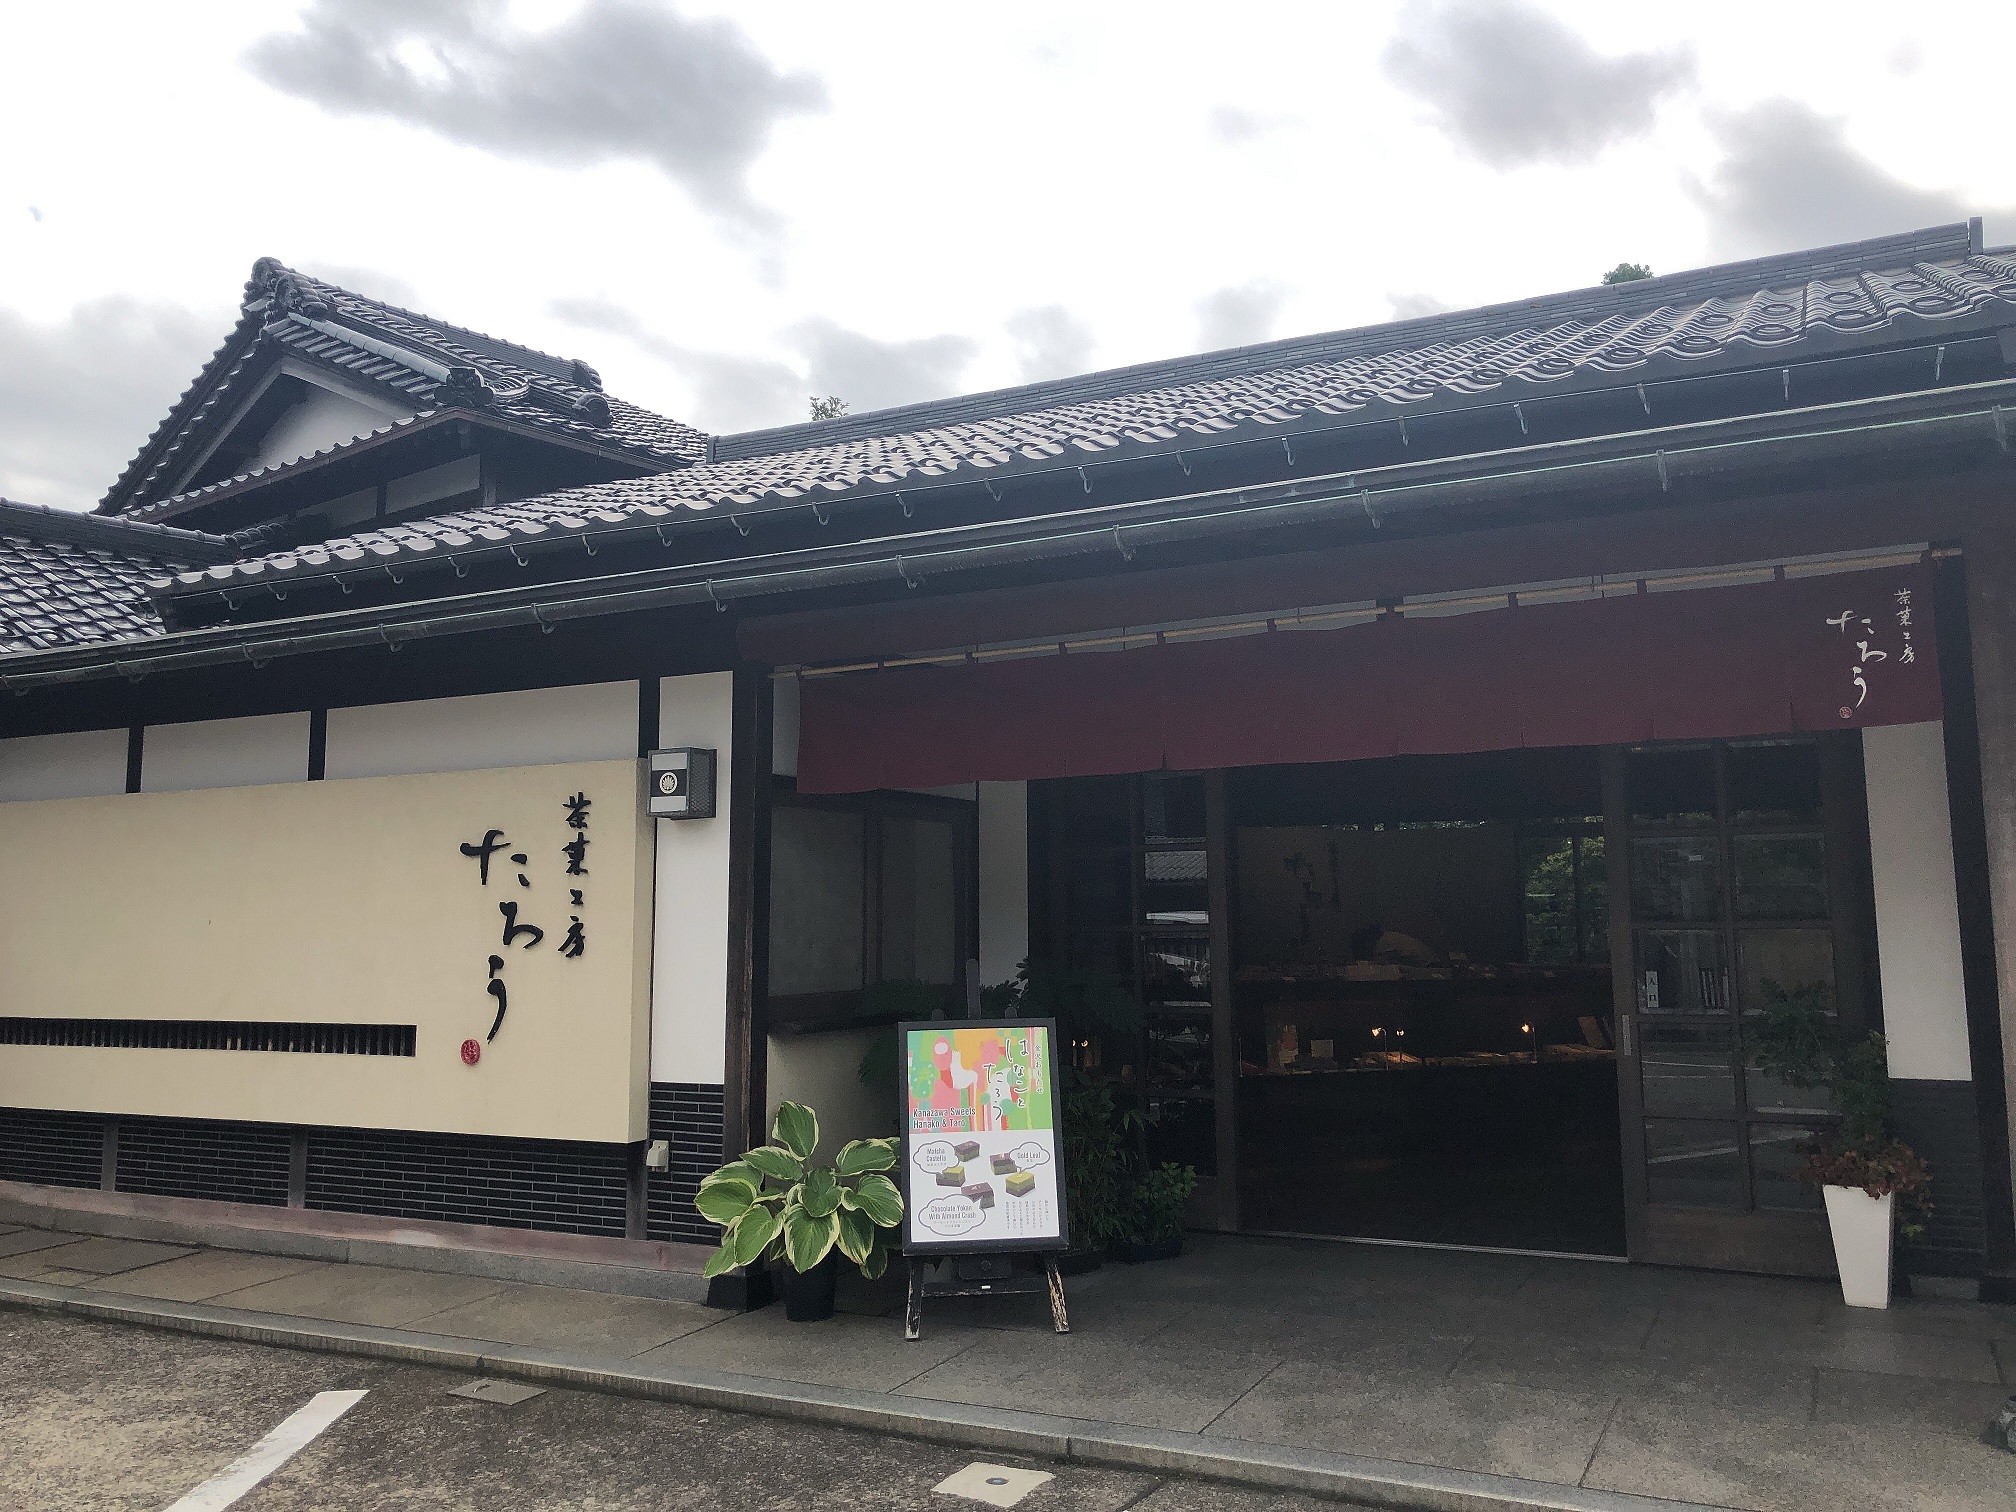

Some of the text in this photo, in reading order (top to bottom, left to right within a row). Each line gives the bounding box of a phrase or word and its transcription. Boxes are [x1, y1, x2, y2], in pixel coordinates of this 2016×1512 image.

[1826, 610, 1888, 708] たろう
[459, 829, 544, 1045] たろう
[913, 1107, 976, 1117] Kanazawa Sweets
[913, 1120, 940, 1129] Hanako
[949, 1119, 966, 1127] Taro
